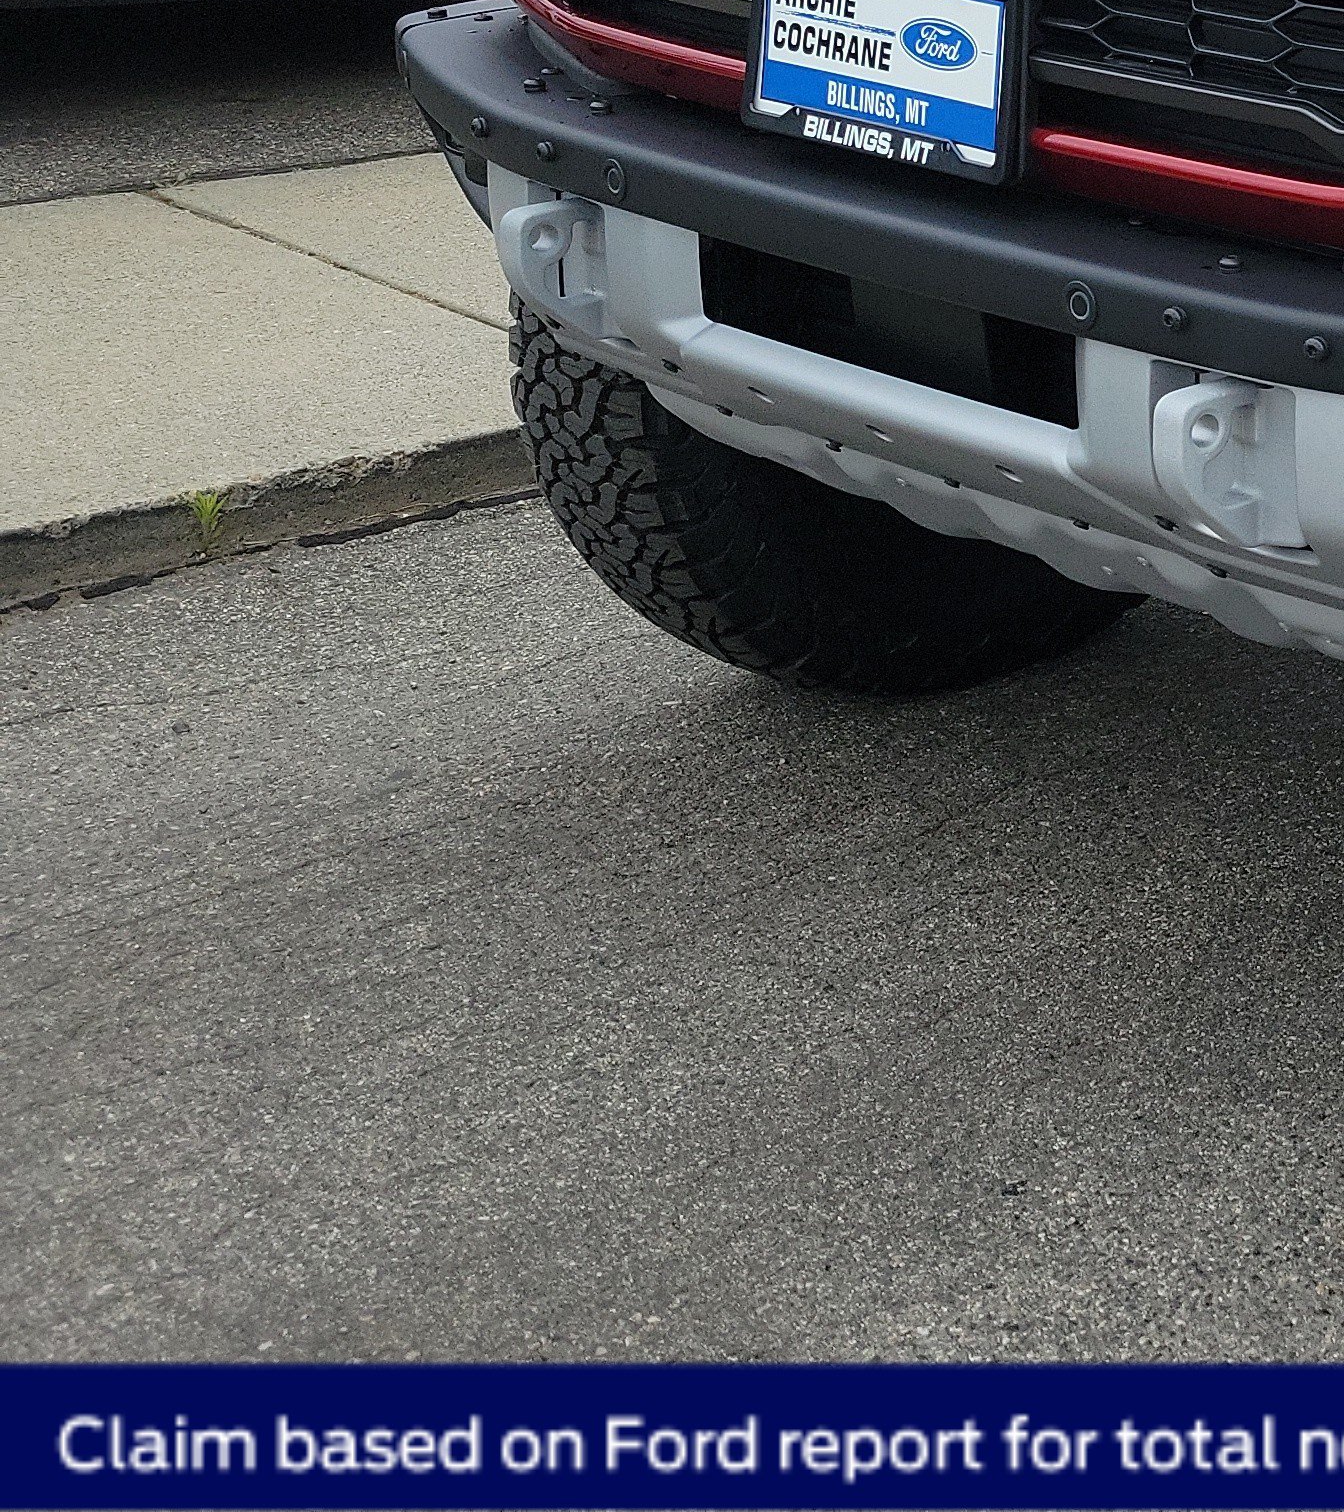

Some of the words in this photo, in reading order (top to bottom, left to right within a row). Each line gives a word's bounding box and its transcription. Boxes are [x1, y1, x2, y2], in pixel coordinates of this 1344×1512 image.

[774, 20, 892, 71] COCHRANE
[915, 25, 960, 62] Ford
[827, 81, 900, 124] BILLINGS,
[905, 98, 929, 126] MT
[803, 115, 895, 158] BILLINGS,
[900, 138, 934, 165] MT
